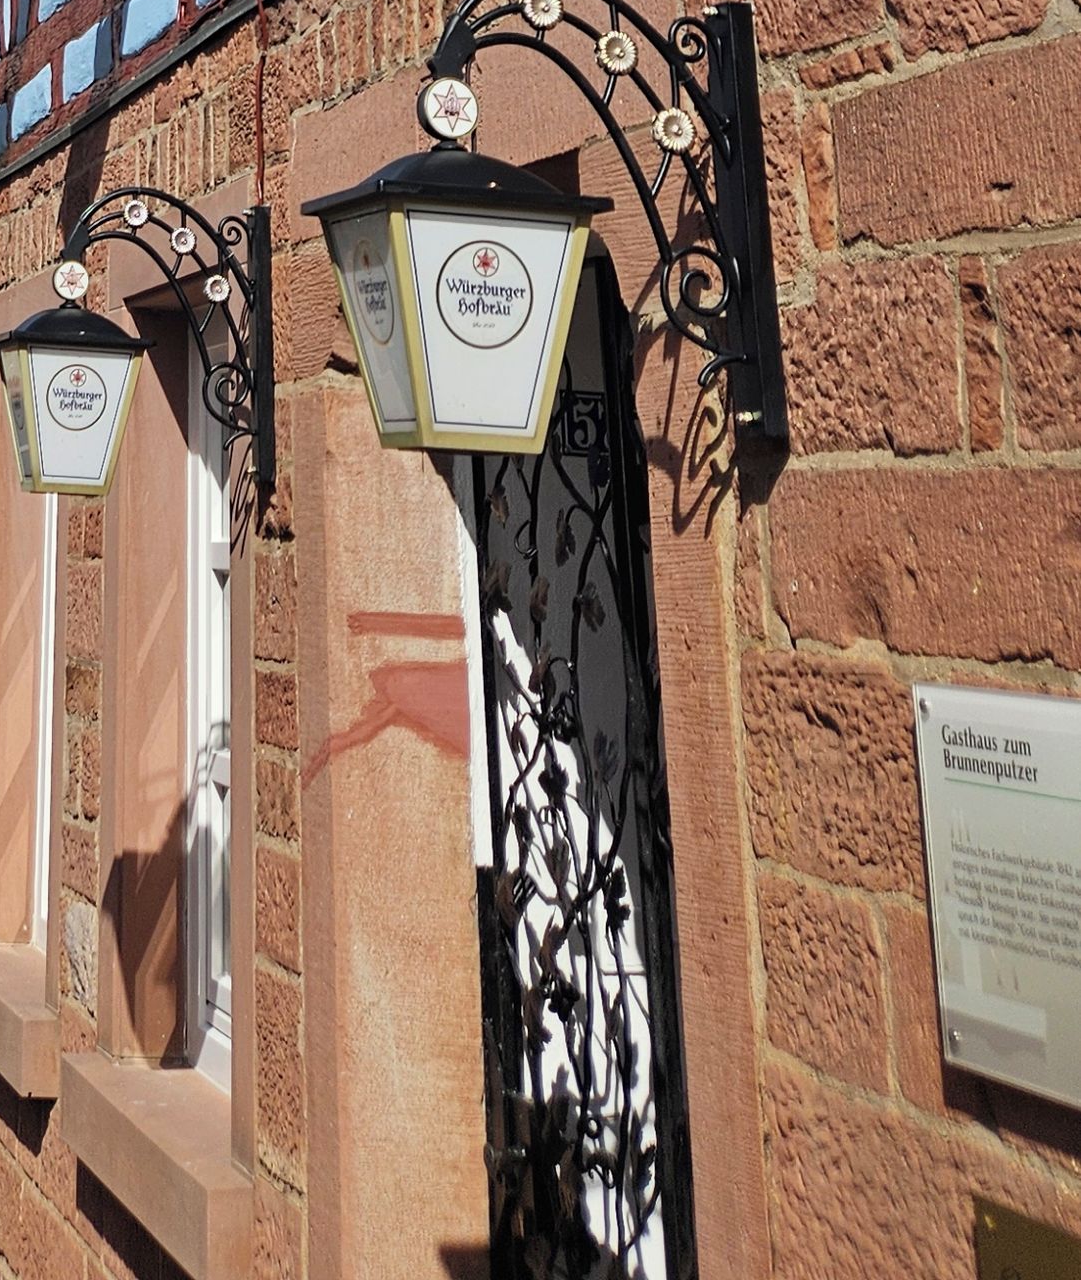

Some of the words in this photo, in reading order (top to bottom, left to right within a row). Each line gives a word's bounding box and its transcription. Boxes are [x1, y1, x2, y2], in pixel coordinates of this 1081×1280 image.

[445, 278, 526, 302] Würzburger
[458, 297, 511, 317] Hofbräu
[52, 387, 103, 403] Würzburger
[941, 724, 998, 752] Gasthaus
[1003, 738, 1032, 757] zum
[943, 748, 1039, 783] Brunnenputzer
